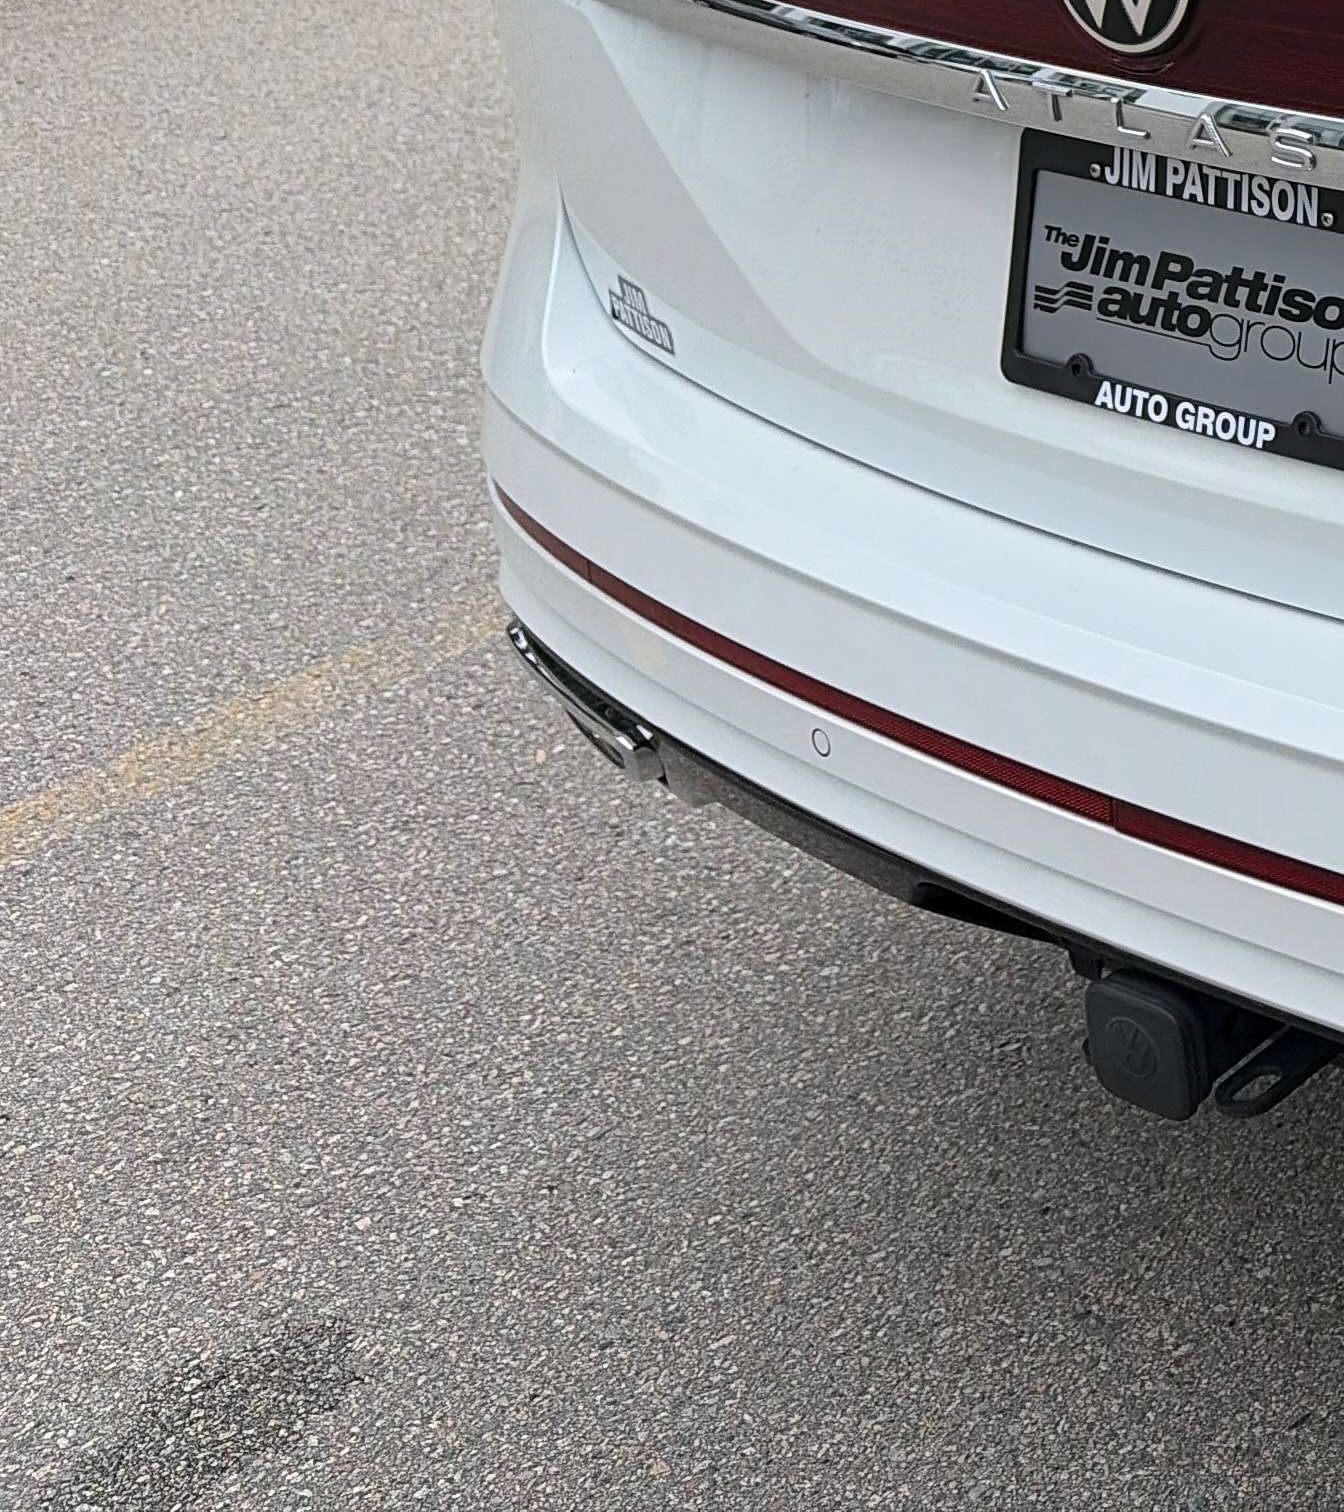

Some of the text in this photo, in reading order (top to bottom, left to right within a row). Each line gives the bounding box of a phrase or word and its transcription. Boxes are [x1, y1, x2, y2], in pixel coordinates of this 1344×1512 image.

[971, 68, 1317, 172] ATLAS
[1104, 146, 1319, 228] JIM PATTISON
[1043, 224, 1080, 248] The
[1094, 379, 1276, 450] AUTO GROUP
